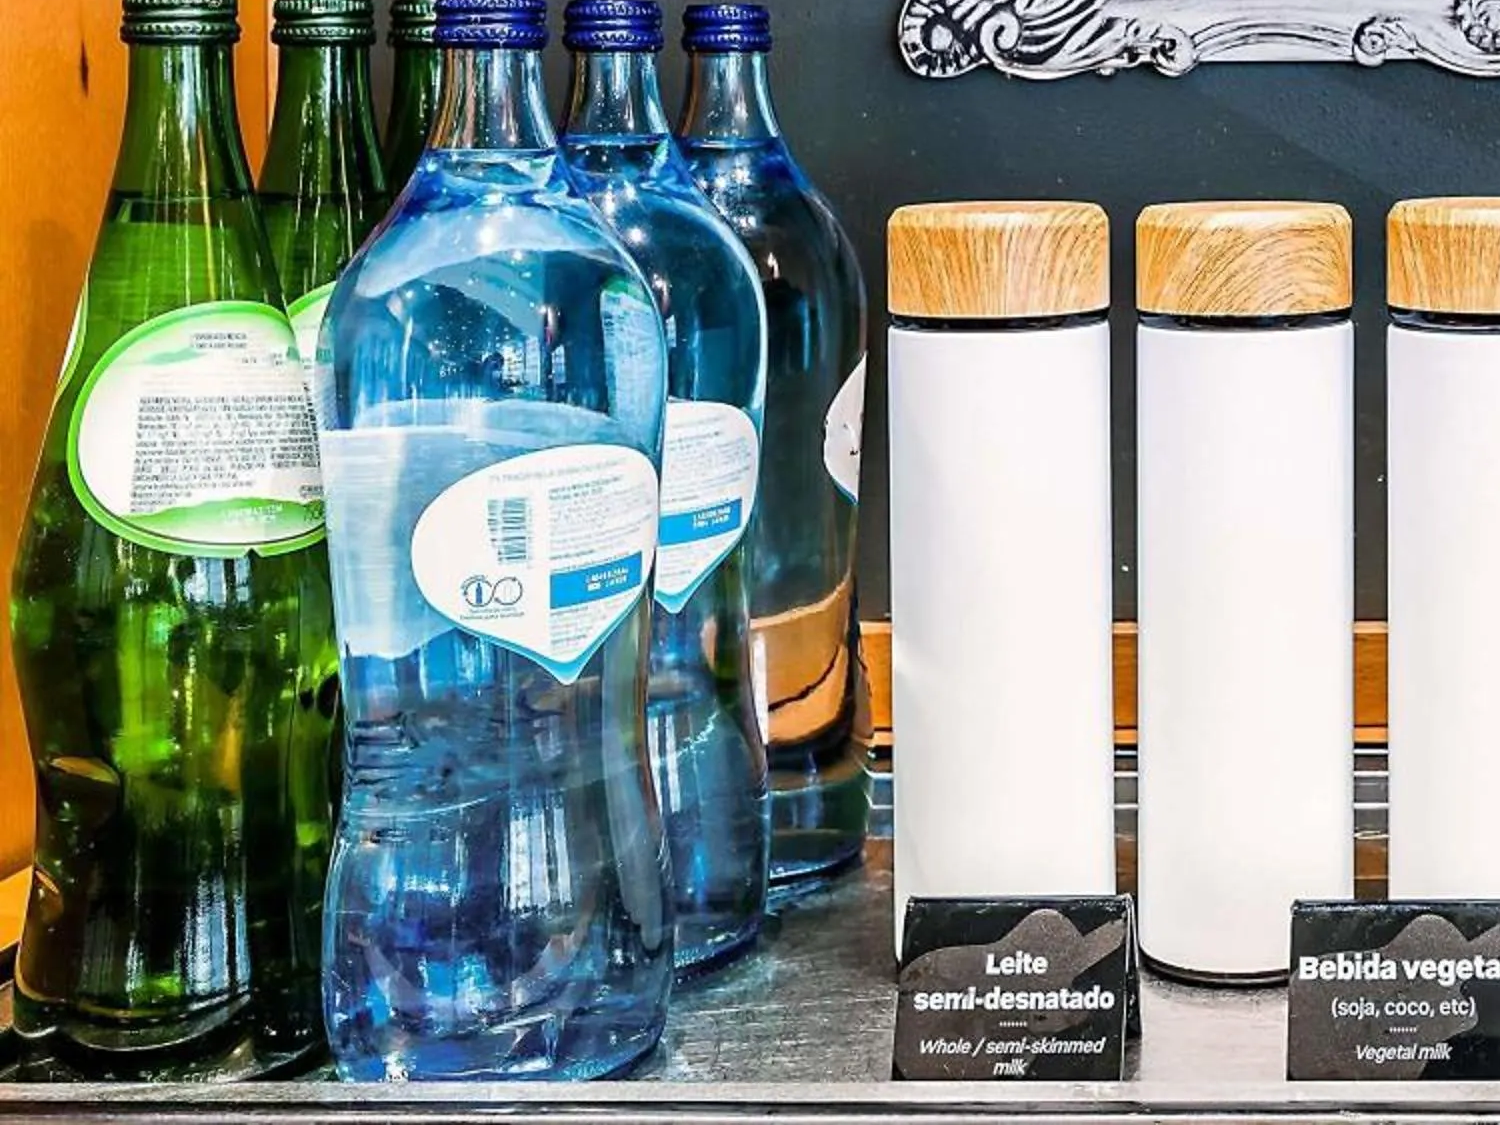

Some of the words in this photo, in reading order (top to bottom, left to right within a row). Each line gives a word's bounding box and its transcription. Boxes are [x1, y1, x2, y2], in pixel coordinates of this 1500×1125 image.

[985, 950, 1049, 976] Leite
[1298, 954, 1397, 981] Bebida
[913, 984, 1115, 1011] semi-desnatado
[1331, 996, 1381, 1020] (soja,
[1383, 1000, 1435, 1018] coco,
[1439, 996, 1476, 1018] etc)
[920, 1038, 972, 1054] Whole
[985, 1036, 1107, 1054] semi-skimmed
[1356, 1043, 1418, 1064] Vegetal
[1417, 1042, 1453, 1060] milk
[993, 1058, 1028, 1076] milk
